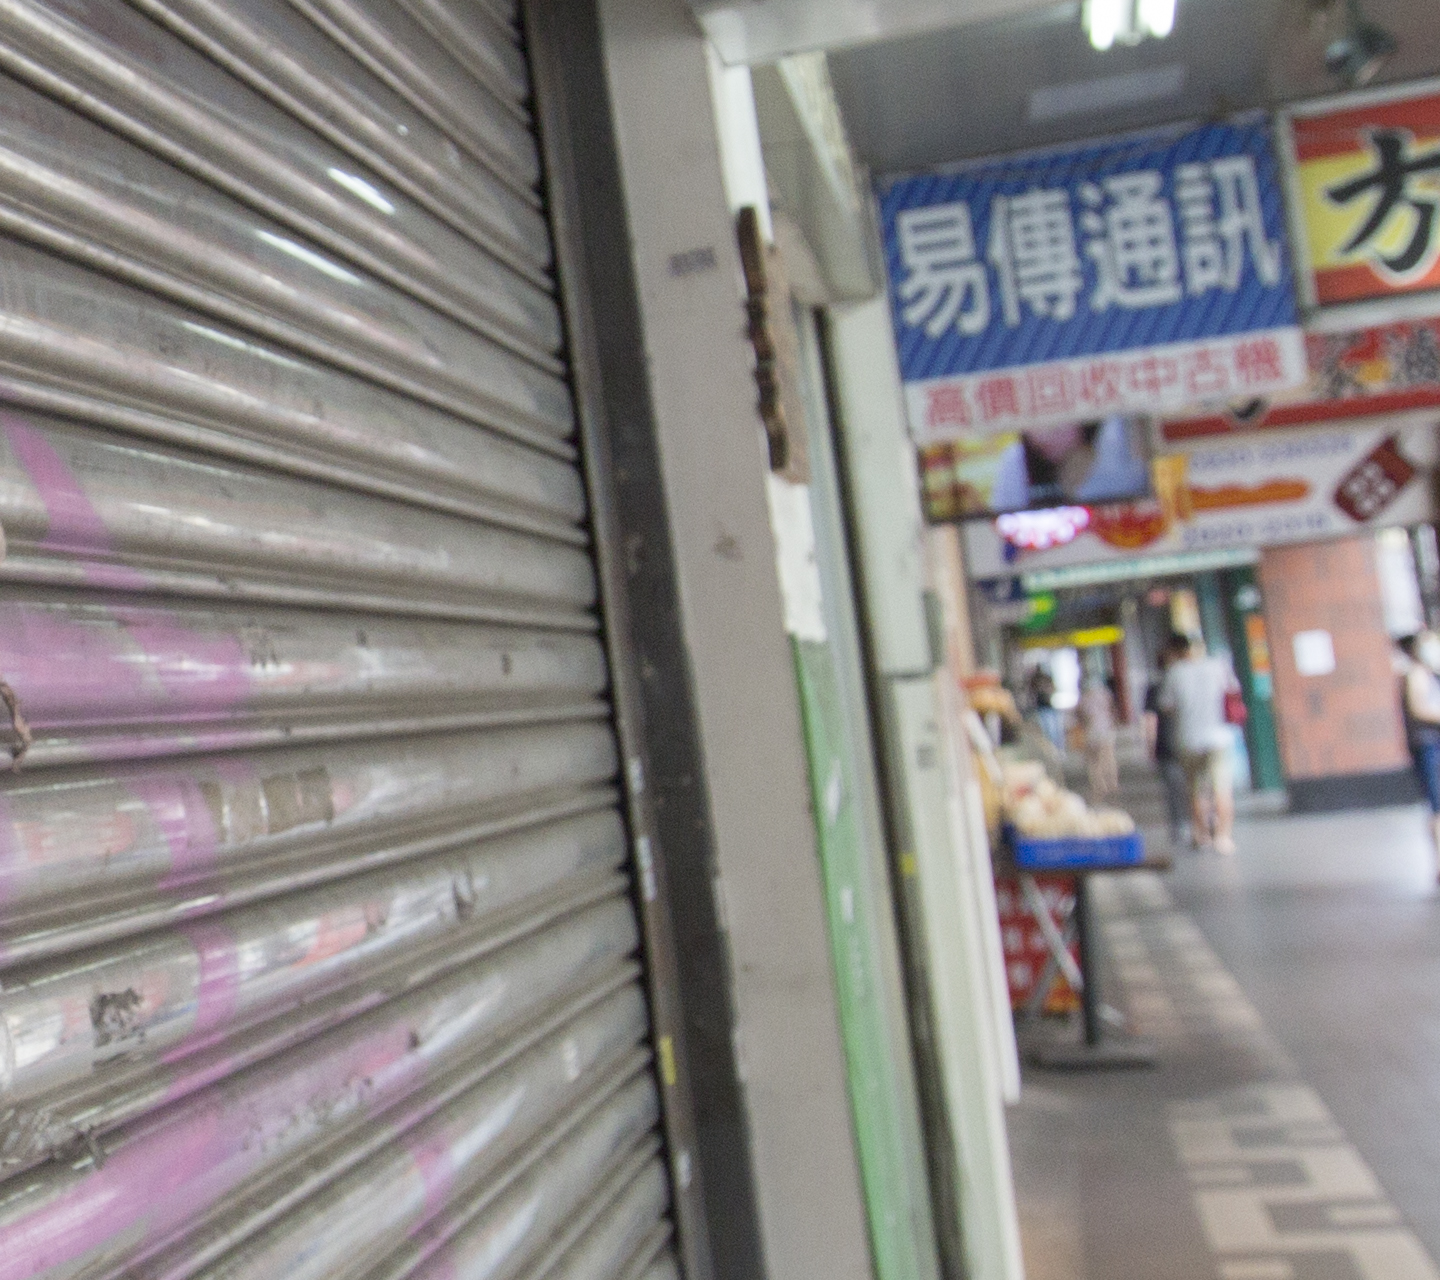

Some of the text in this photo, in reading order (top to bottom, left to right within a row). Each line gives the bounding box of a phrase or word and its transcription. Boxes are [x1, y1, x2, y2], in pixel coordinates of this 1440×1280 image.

[892, 154, 1286, 340] 易傳通訊
[922, 338, 1287, 432] 高價回收中古機
